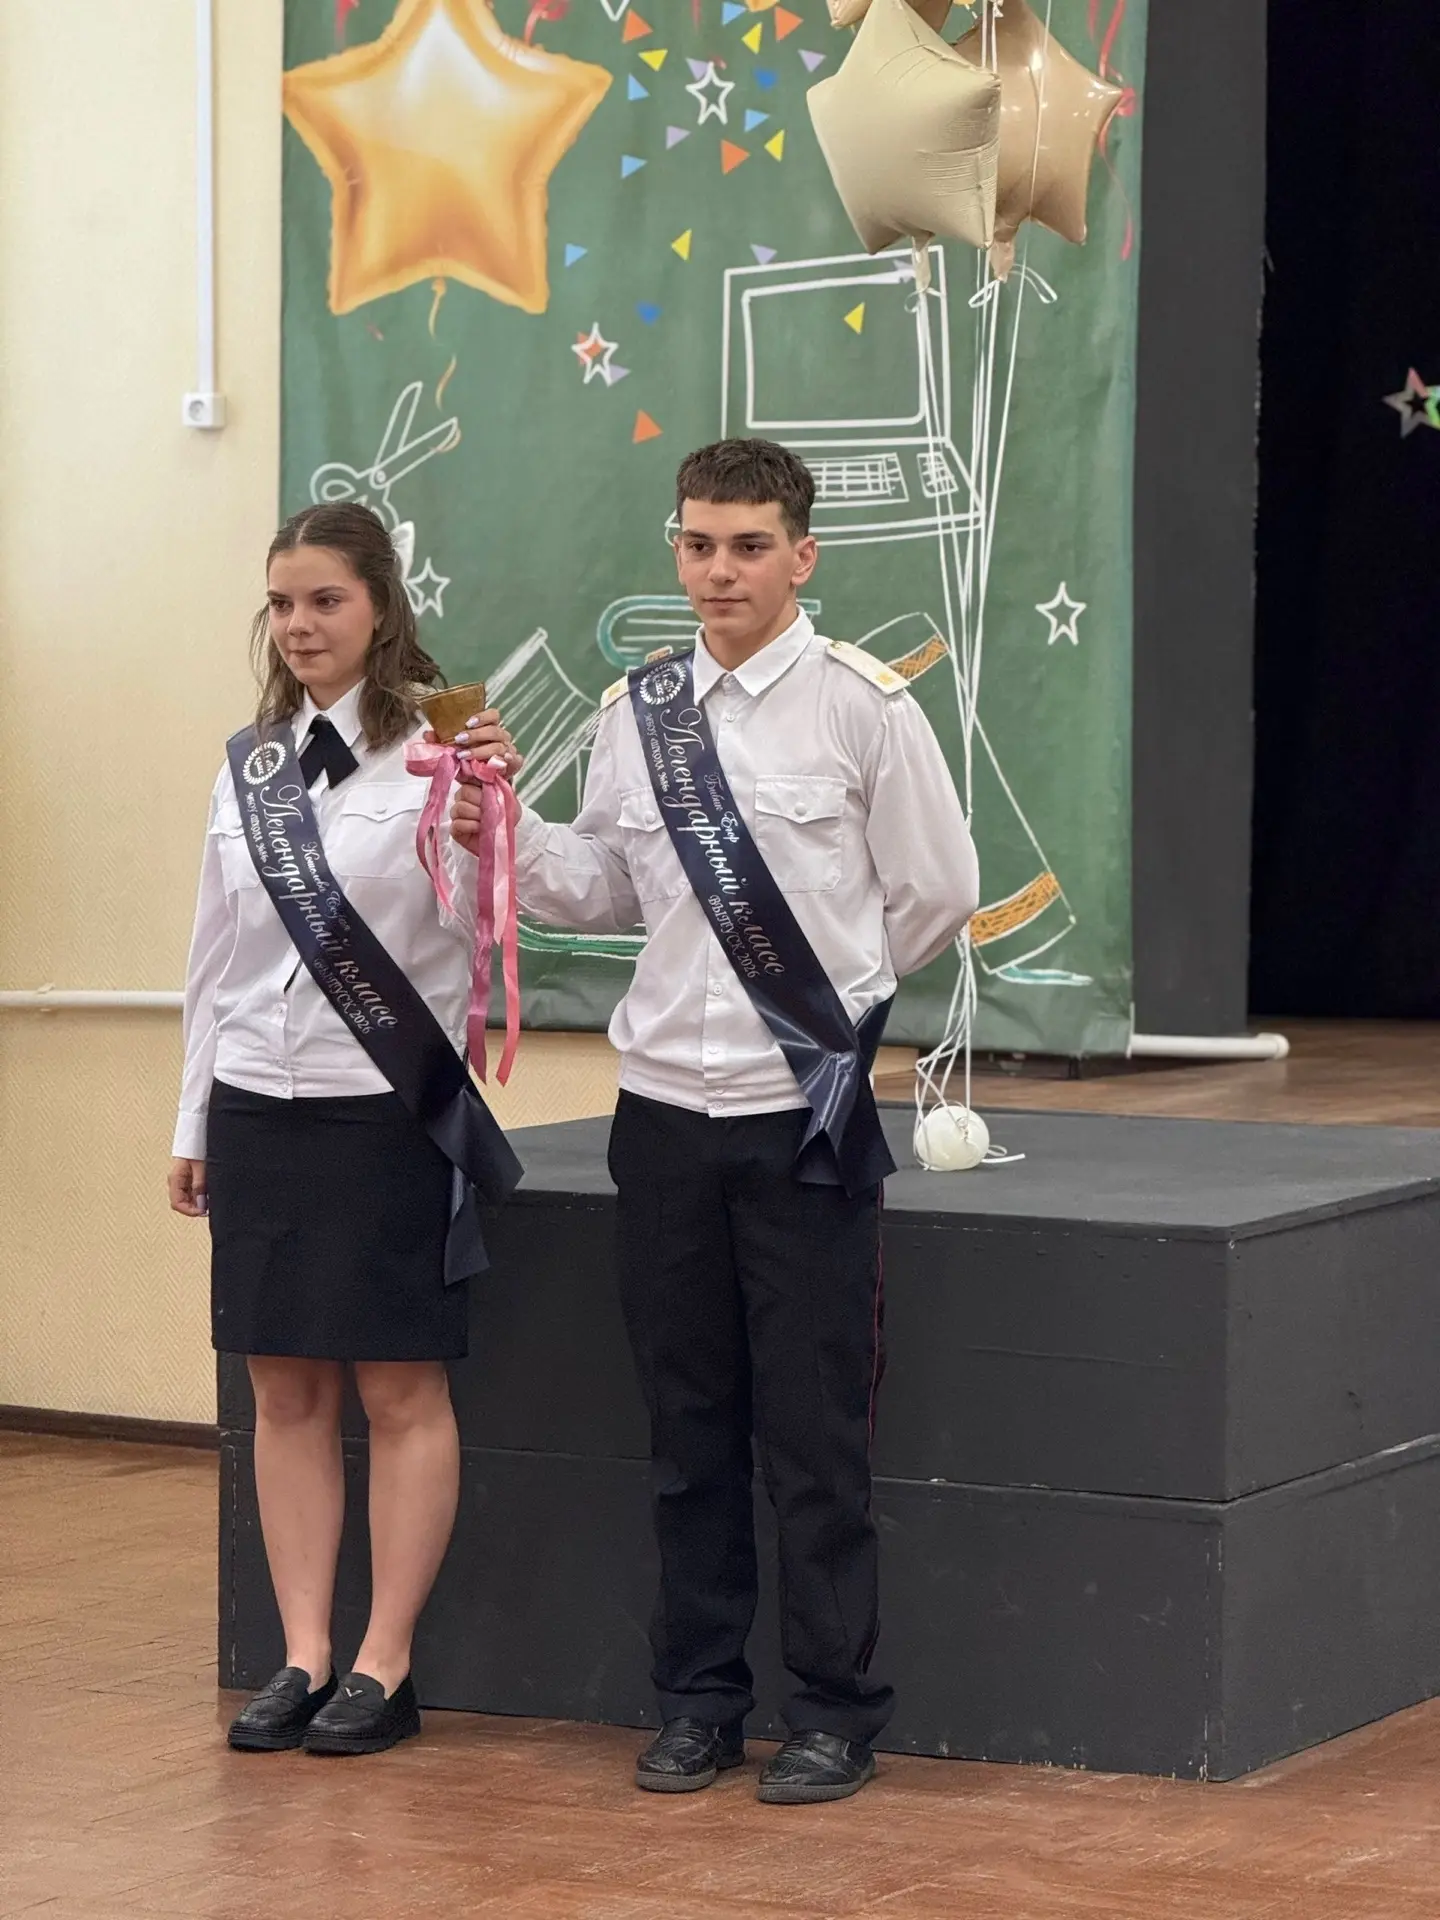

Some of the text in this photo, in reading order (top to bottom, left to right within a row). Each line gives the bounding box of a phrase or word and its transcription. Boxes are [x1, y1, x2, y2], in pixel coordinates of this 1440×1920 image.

[659, 707, 785, 975] Легендарный класс
[721, 811, 740, 843] Егор
[260, 784, 398, 1029] Легендарный класс
[708, 894, 761, 979] ВЫПУСК 2026
[350, 1010, 375, 1035] 2026
